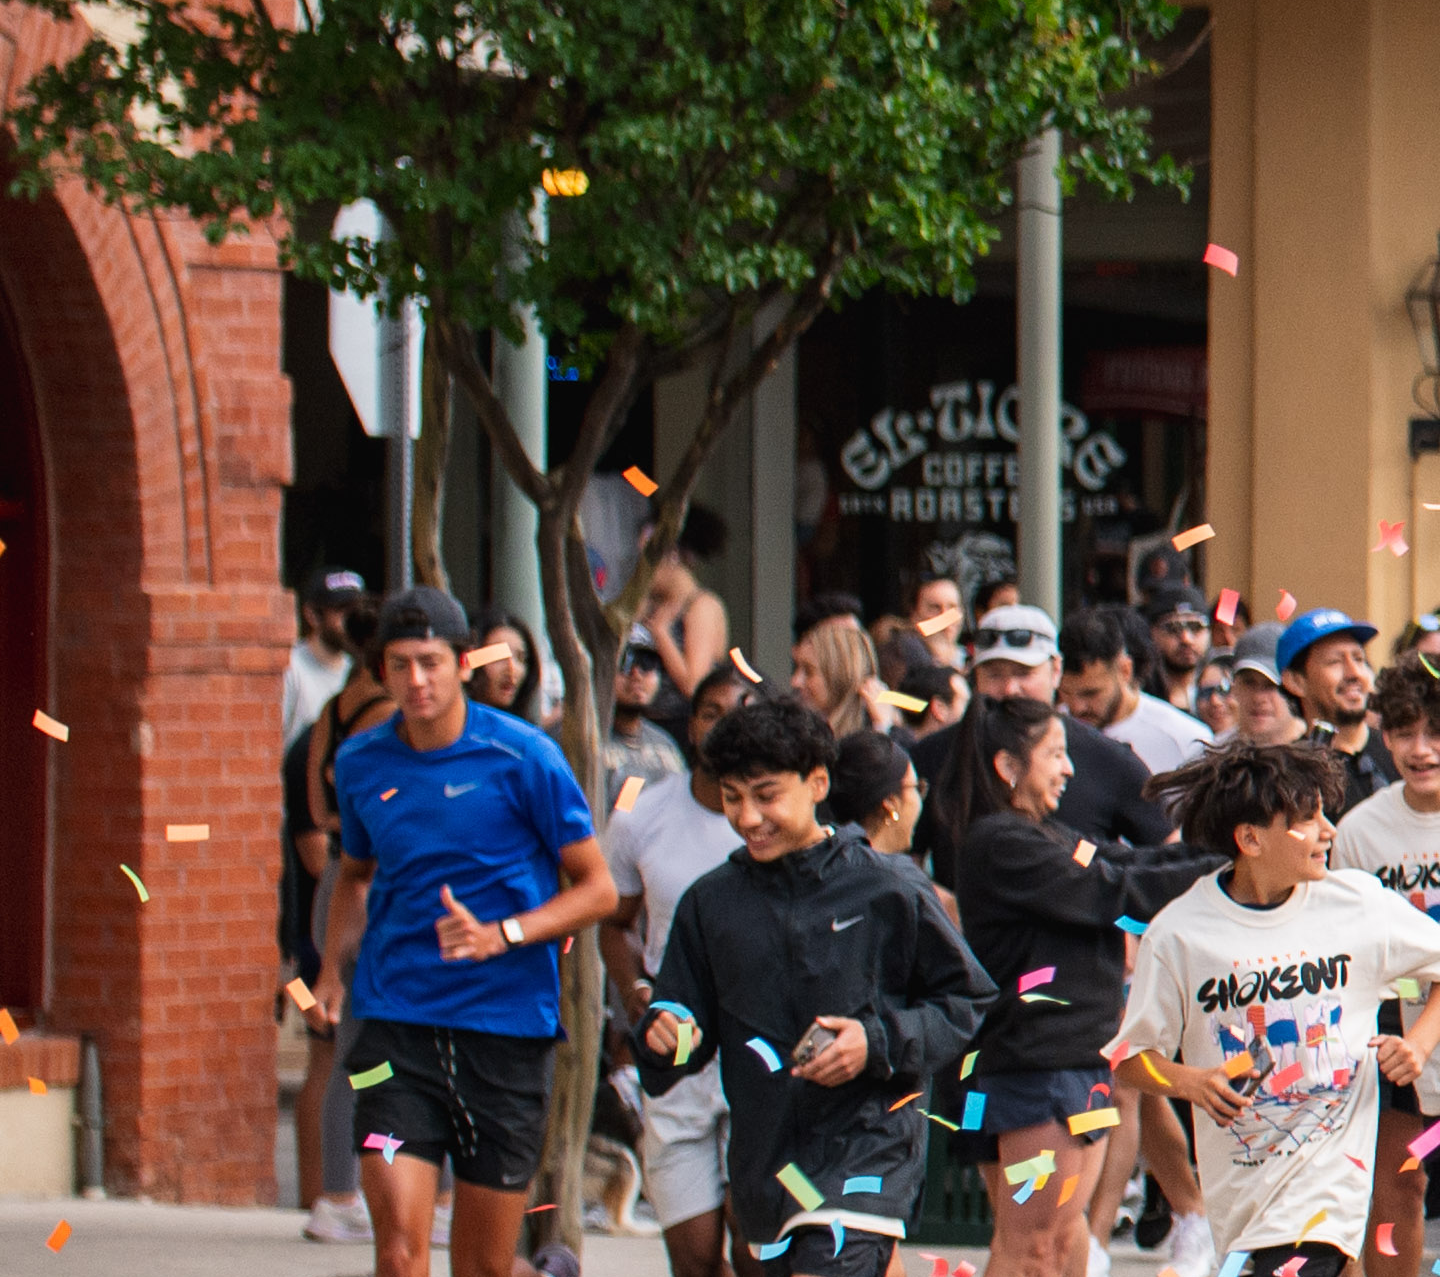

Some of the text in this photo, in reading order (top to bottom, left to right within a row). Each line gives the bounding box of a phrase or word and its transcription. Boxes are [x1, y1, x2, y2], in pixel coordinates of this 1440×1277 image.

[922, 453, 1020, 487] COFFE
[891, 489, 1076, 522] ROASTS
[1197, 953, 1351, 1013] SHAKEOUT
